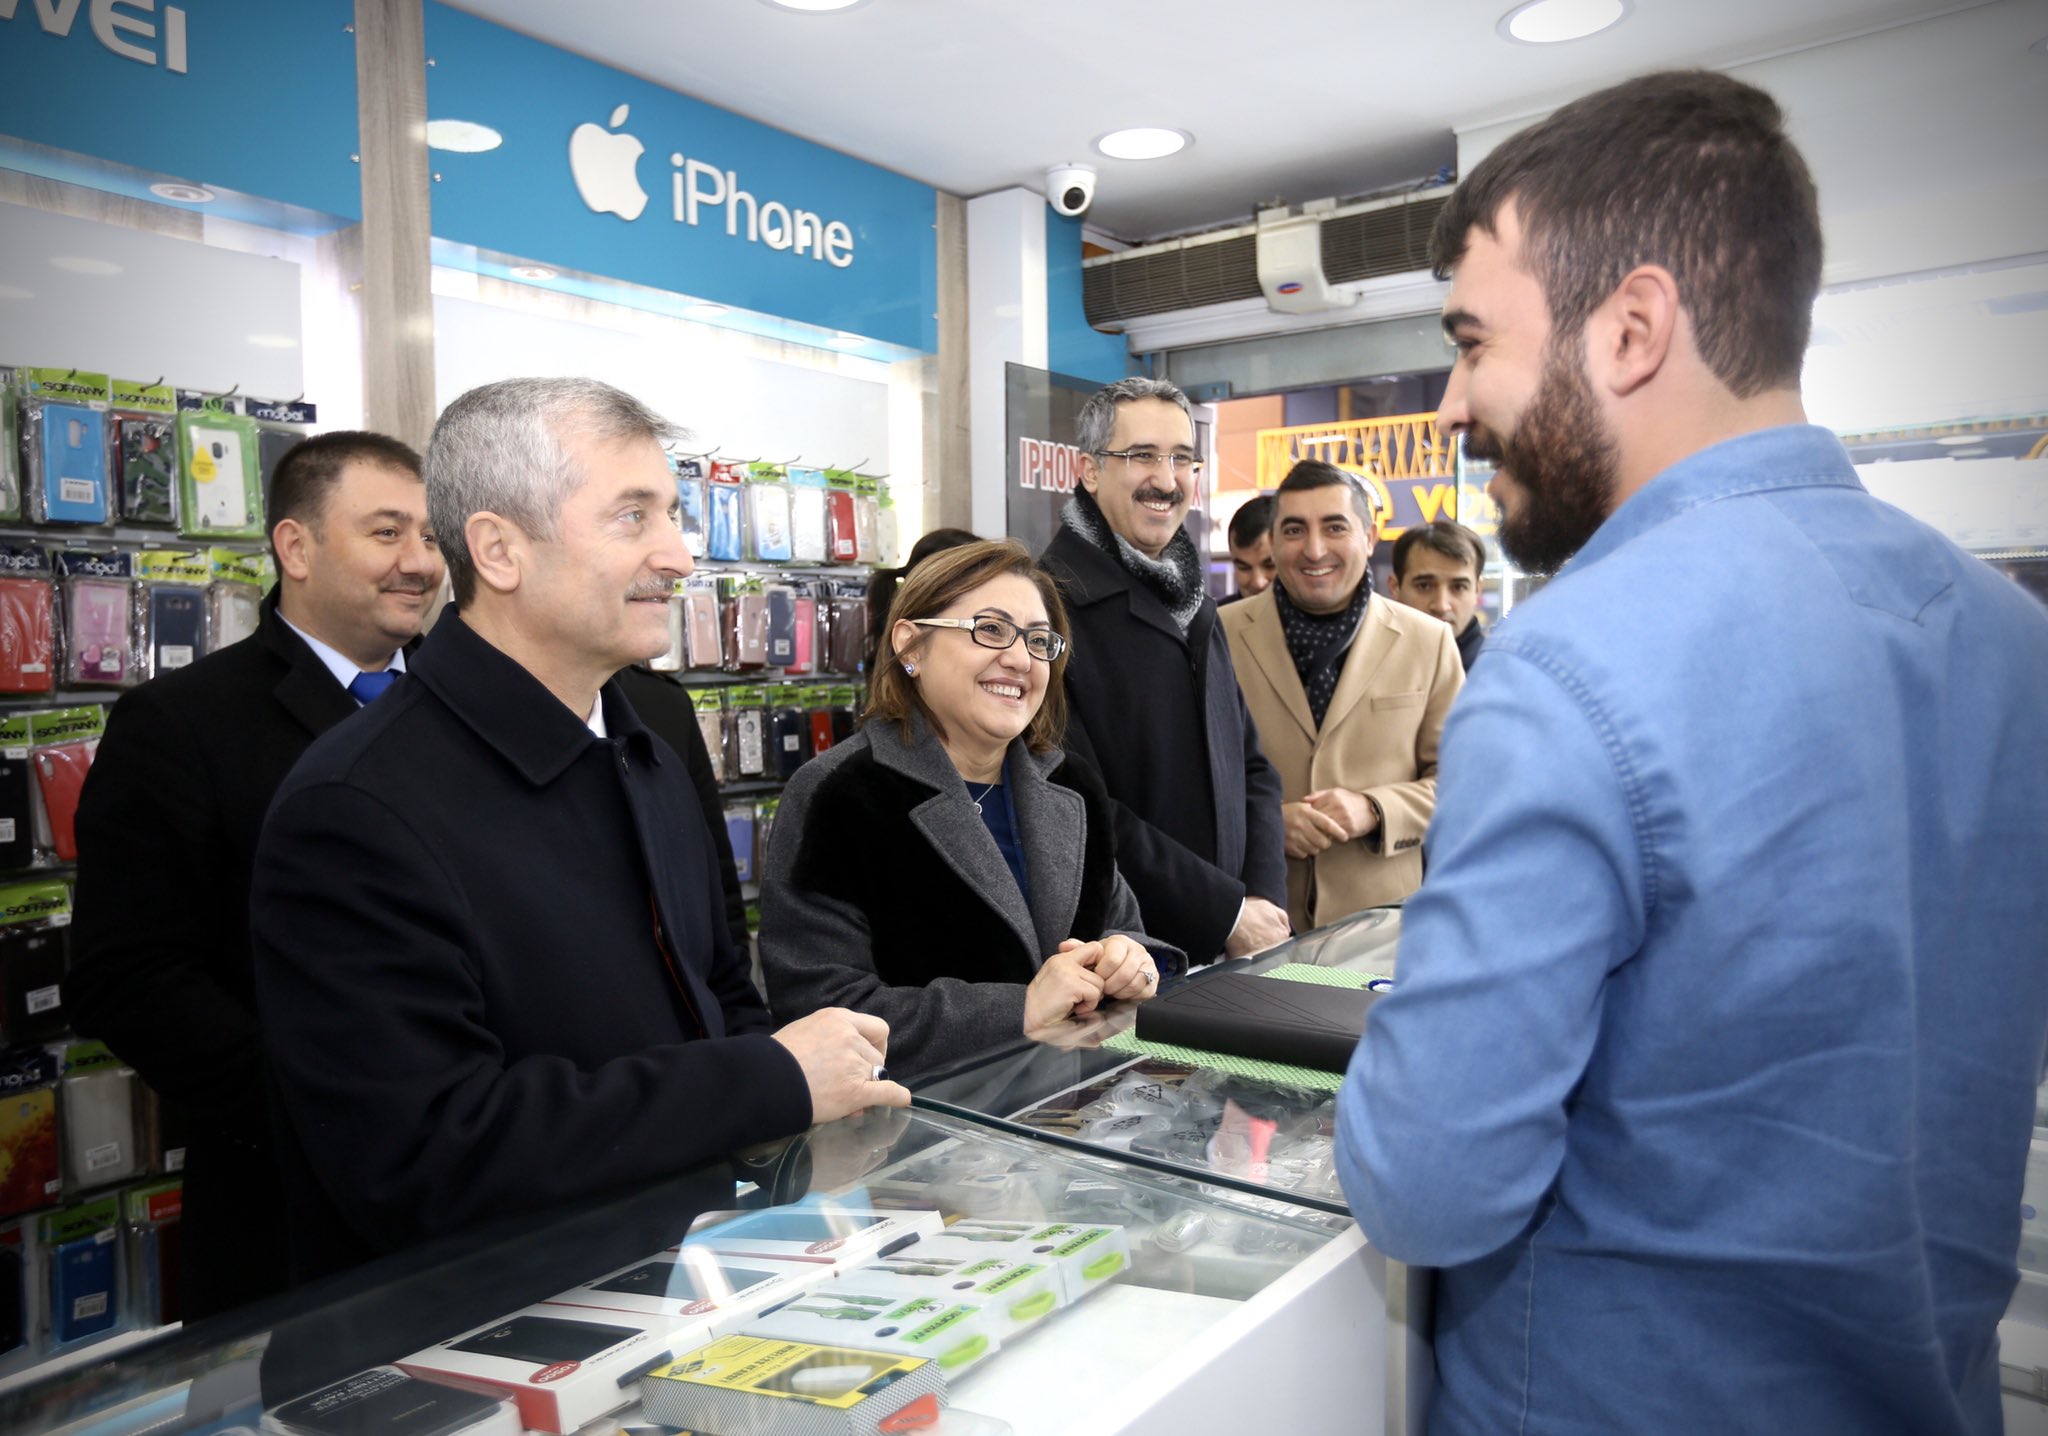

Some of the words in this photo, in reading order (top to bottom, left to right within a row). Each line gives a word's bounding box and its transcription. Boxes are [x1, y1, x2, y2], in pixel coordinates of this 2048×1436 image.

[670, 152, 855, 268] iPhone
[42, 381, 106, 397] SOFFANY
[537, 1360, 579, 1383] 10500
